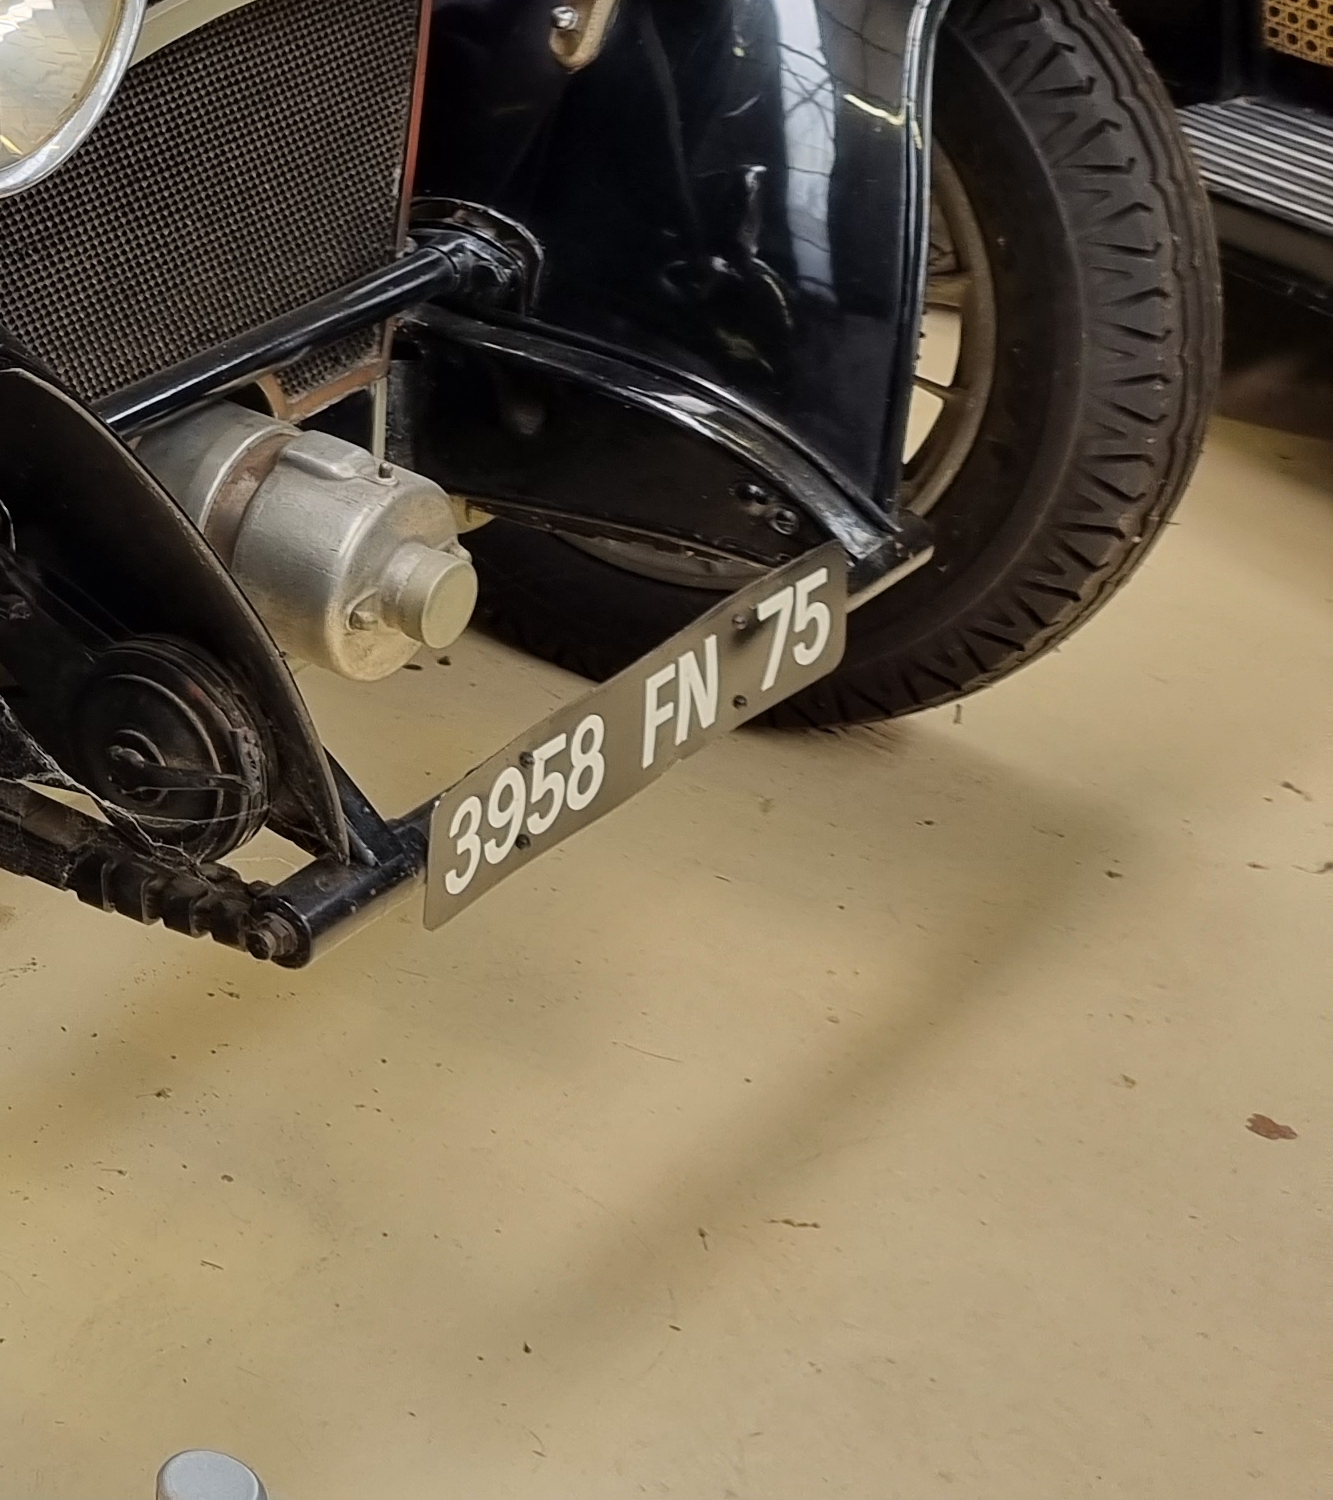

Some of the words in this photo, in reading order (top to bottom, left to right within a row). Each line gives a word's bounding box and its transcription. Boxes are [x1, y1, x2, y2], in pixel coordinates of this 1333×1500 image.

[444, 713, 606, 895] 3958
[642, 633, 719, 770] FN
[756, 567, 831, 693] 75
